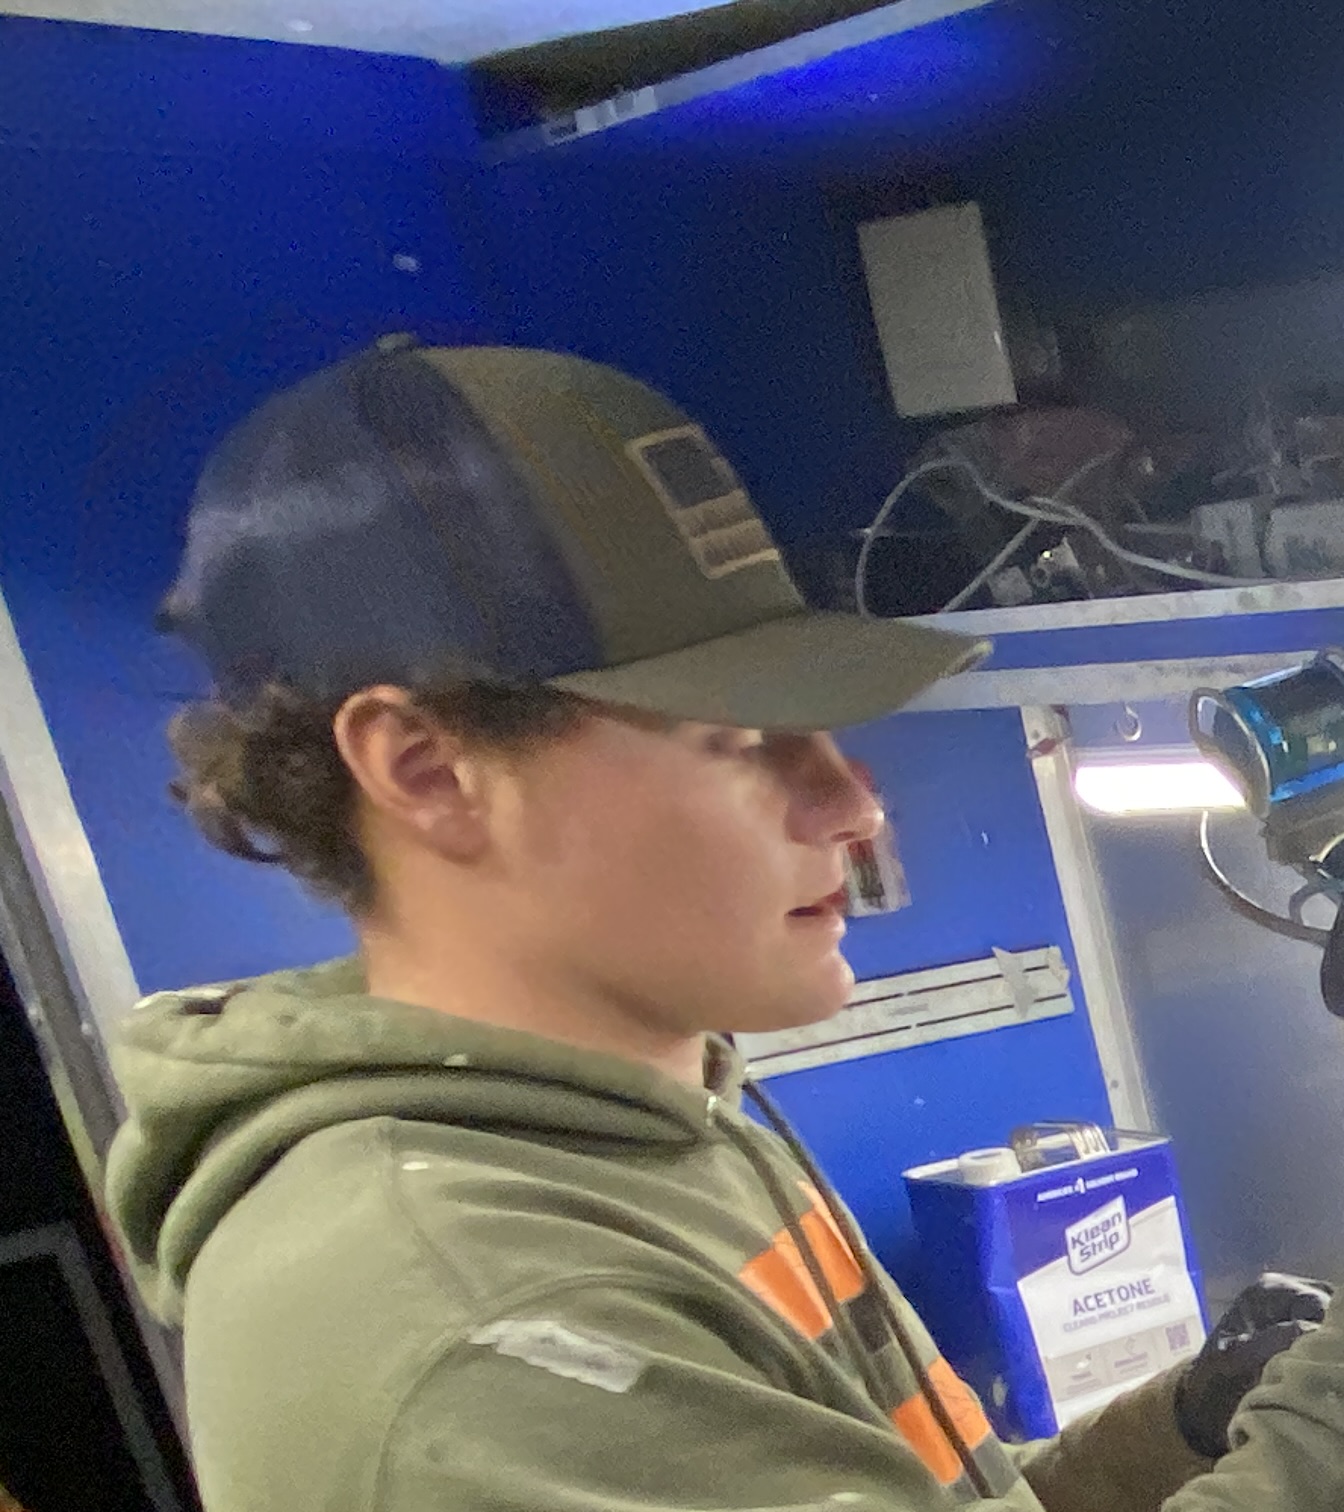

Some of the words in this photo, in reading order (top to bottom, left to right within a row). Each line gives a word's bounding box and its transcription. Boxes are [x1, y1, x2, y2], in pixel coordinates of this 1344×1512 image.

[1071, 1212, 1122, 1250] Klean
[1080, 1231, 1119, 1263] Strip
[1073, 1278, 1156, 1316] ACETONE
